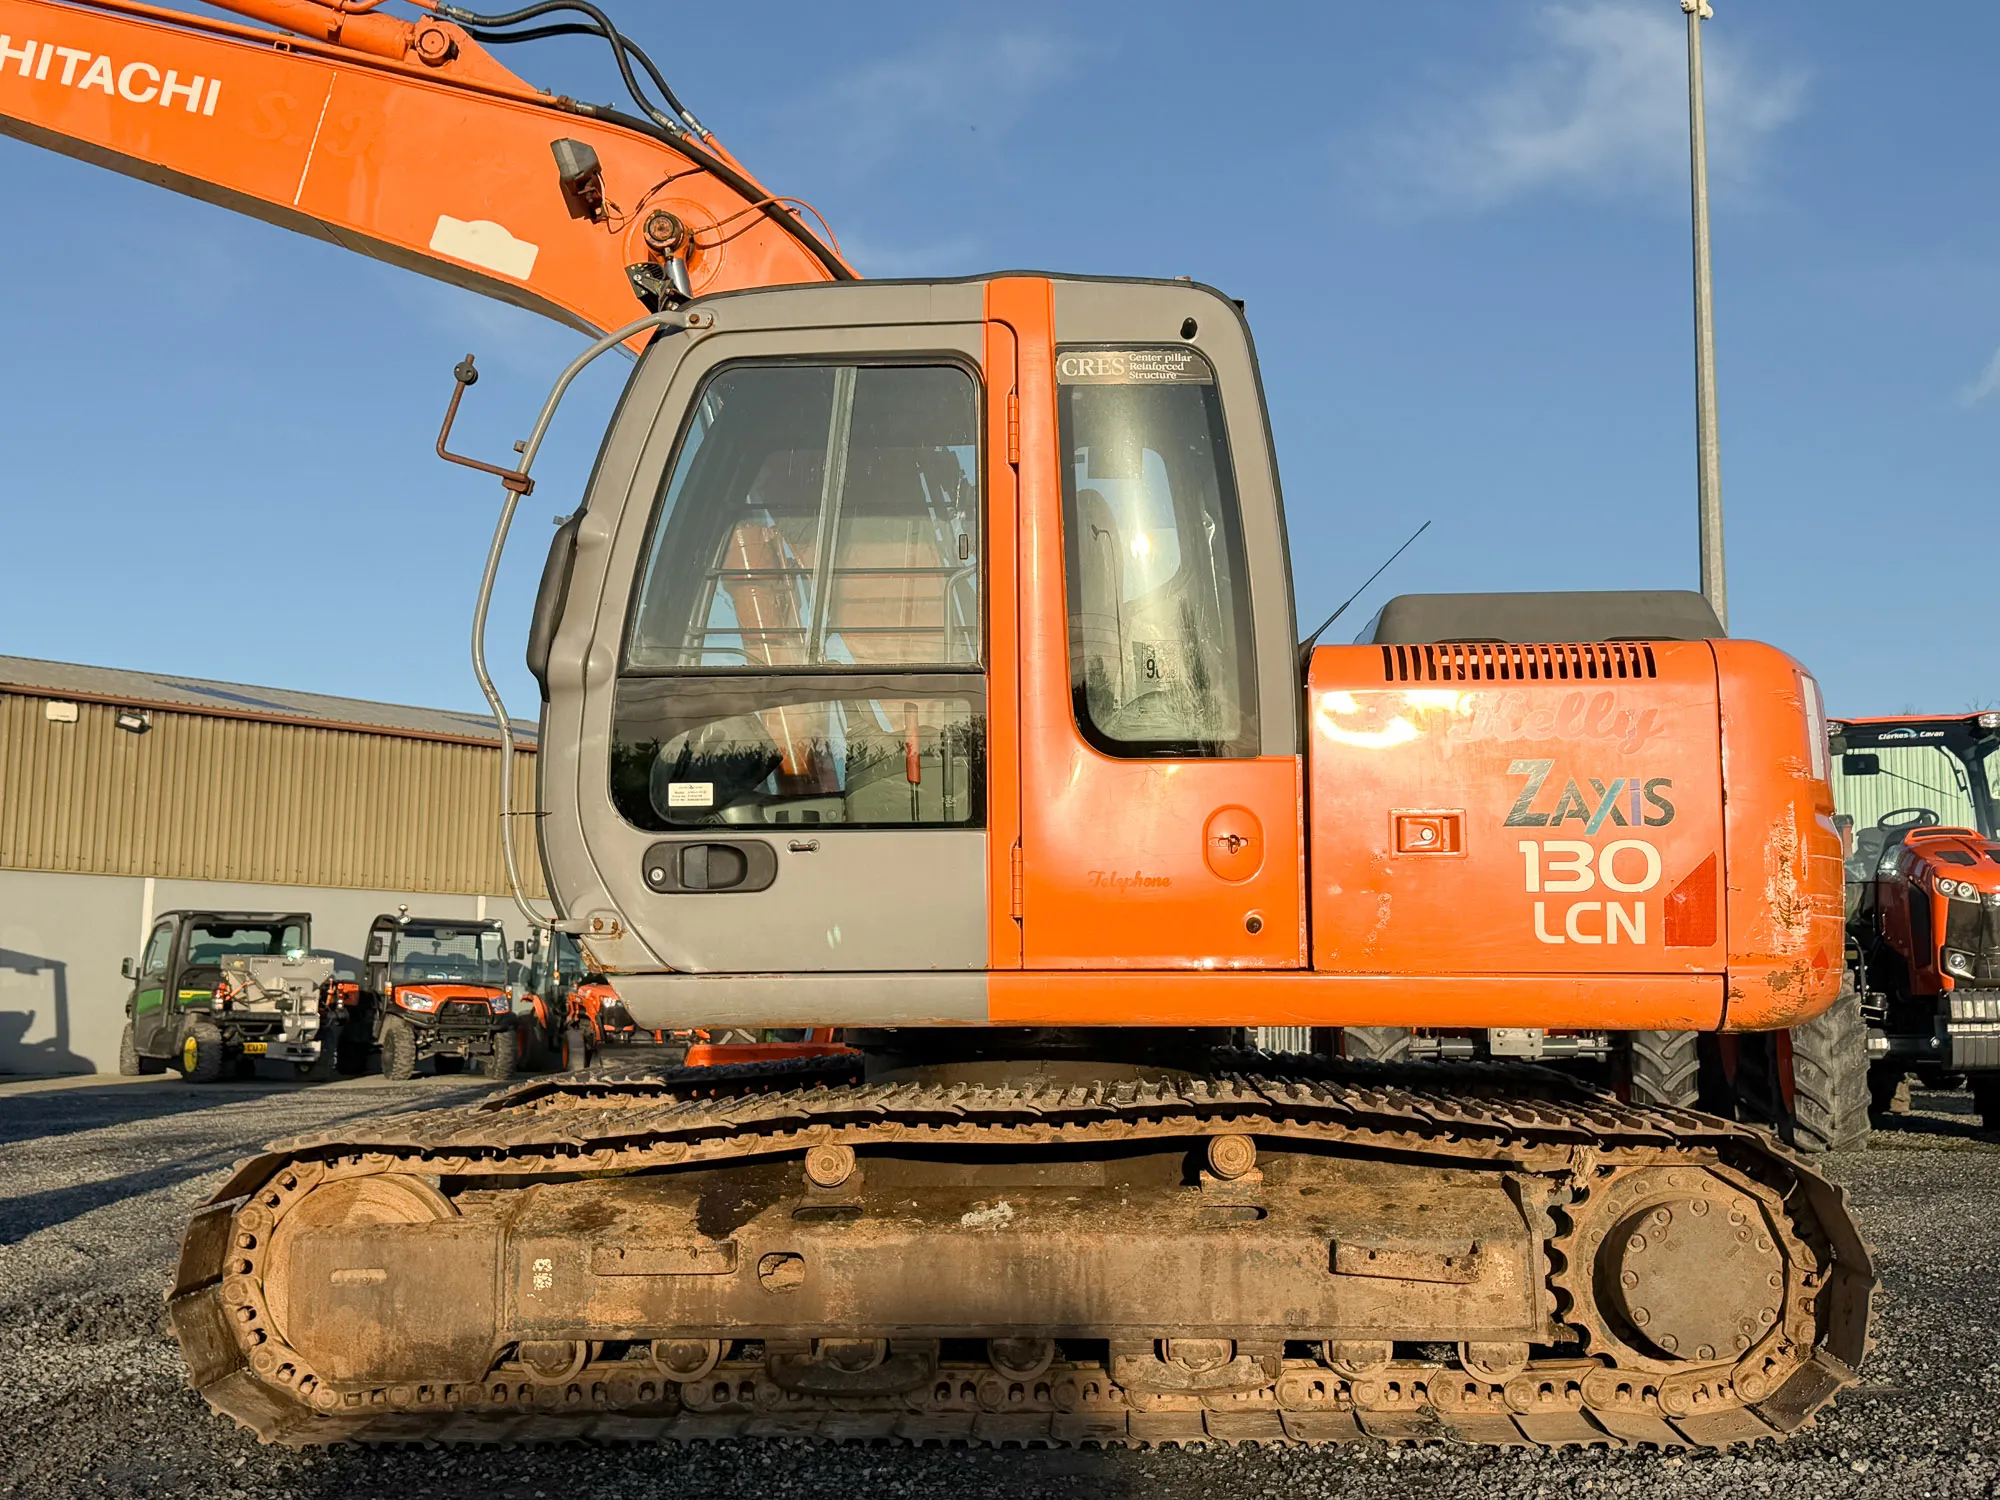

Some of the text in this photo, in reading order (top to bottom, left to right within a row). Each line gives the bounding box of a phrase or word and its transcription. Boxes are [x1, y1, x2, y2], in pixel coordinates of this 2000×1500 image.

[0, 34, 222, 117] HITACHI
[1061, 358, 1125, 377] CRES
[1129, 352, 1193, 363] Center pillar
[1129, 361, 1185, 371] Reinforced
[1129, 370, 1177, 380] Structure
[1502, 758, 1676, 835] ZAXIS
[1518, 839, 1663, 893] 130
[1087, 870, 1173, 895] Telephone
[1534, 901, 1647, 945] LCN
